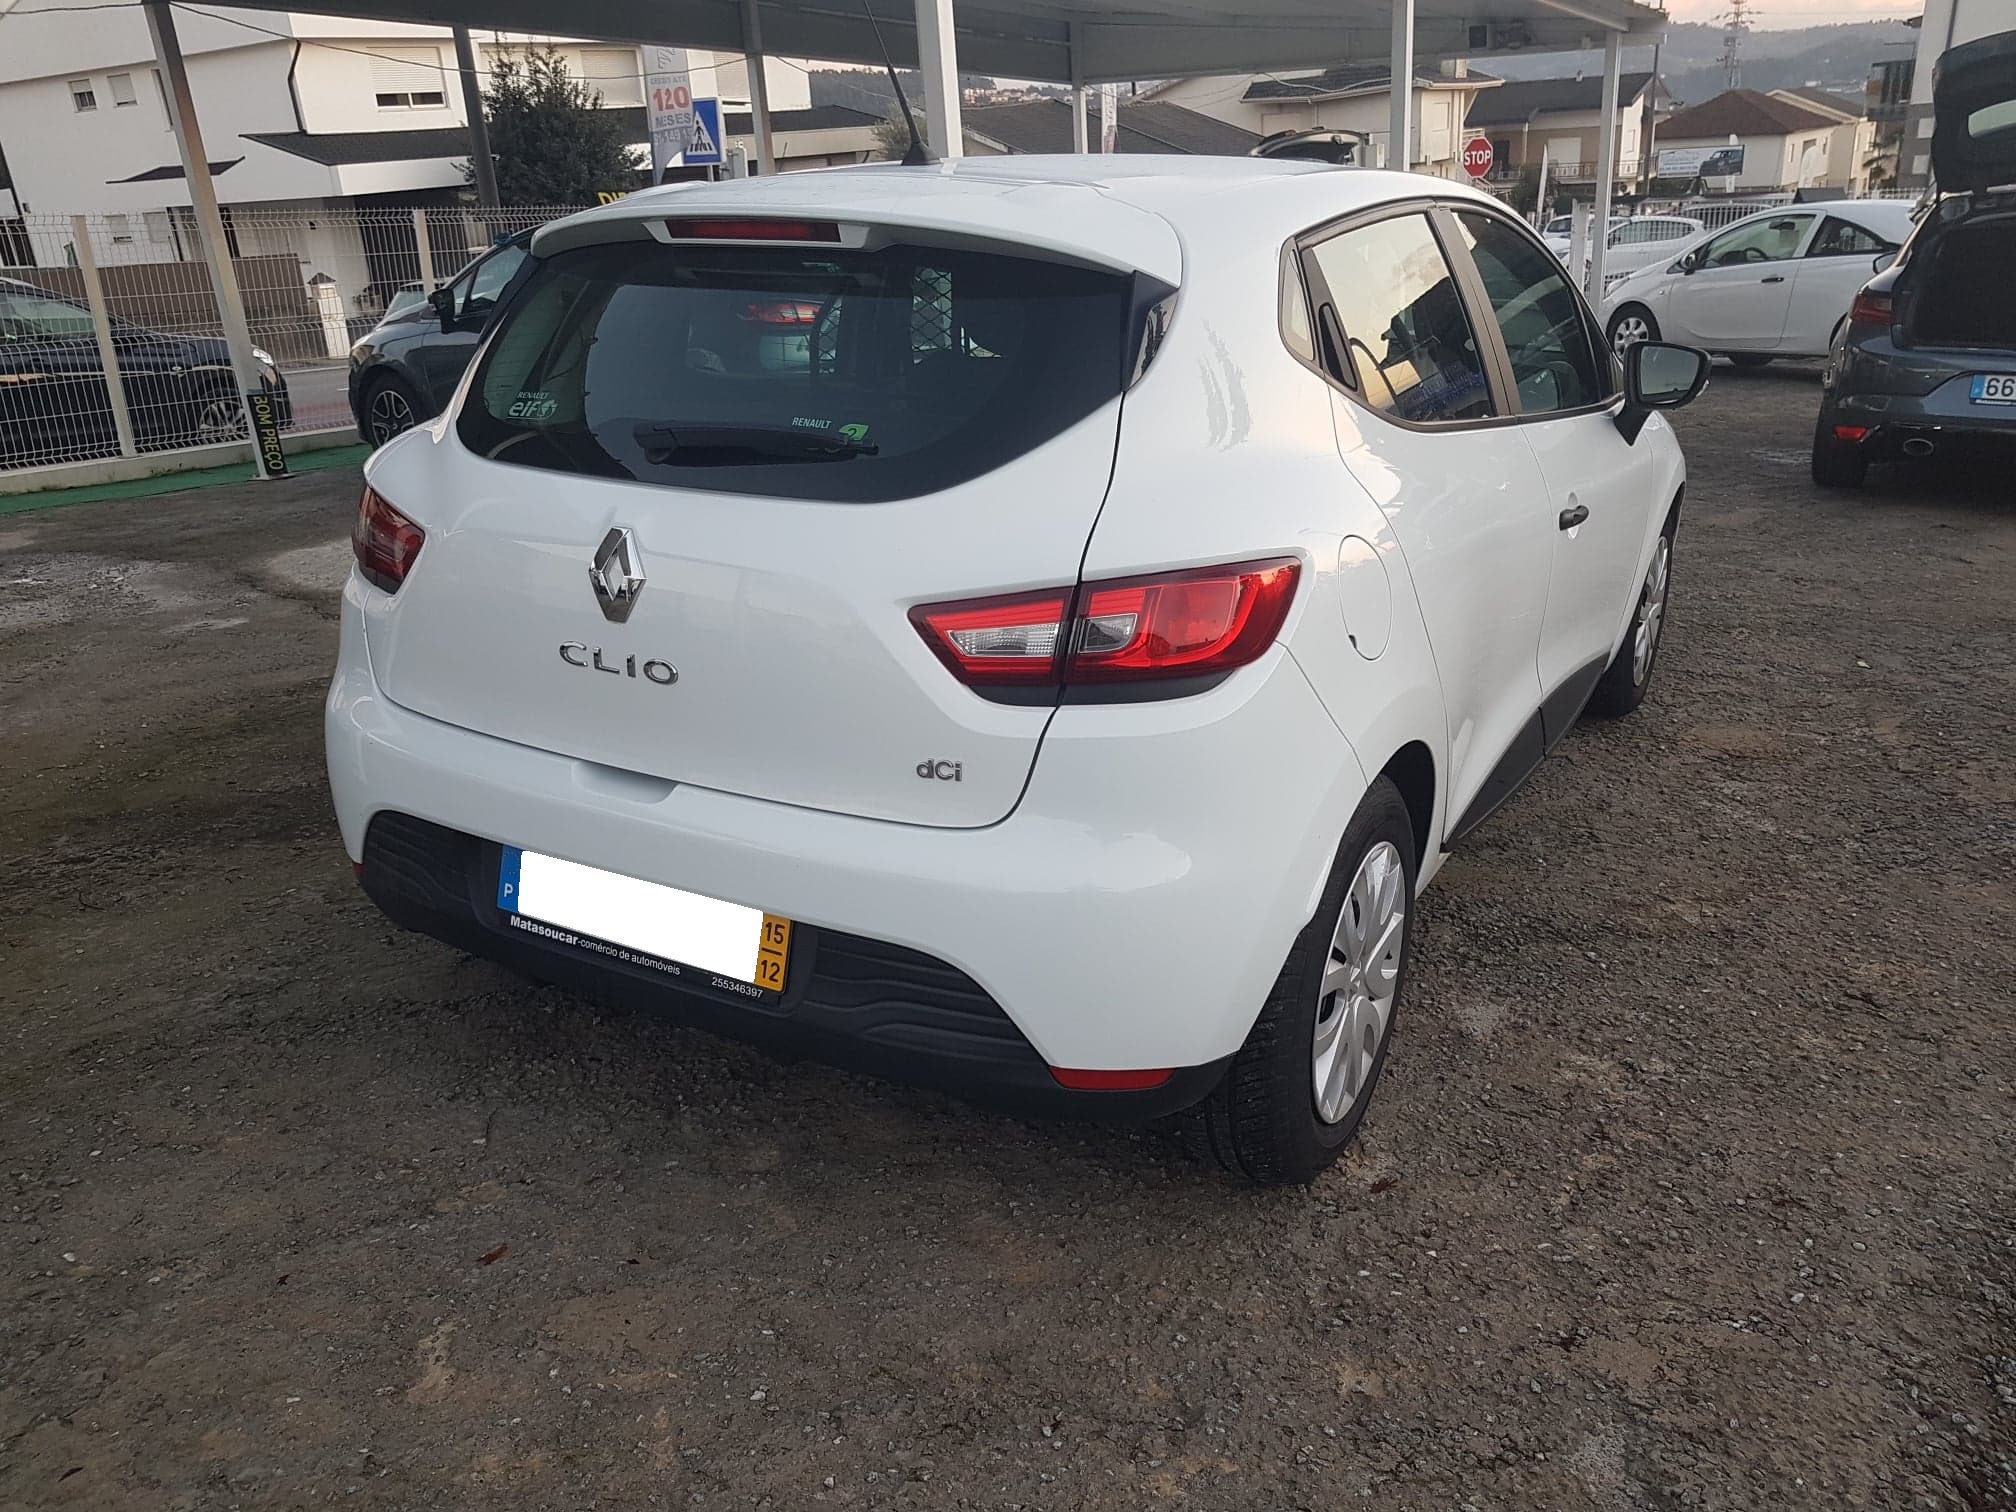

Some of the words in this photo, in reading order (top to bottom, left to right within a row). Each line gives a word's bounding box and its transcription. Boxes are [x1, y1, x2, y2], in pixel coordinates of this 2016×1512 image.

[653, 86, 690, 111] 120
[656, 113, 692, 128] MESES
[1464, 150, 1491, 166] STOP
[253, 396, 273, 425] BOM
[509, 400, 541, 417] elf
[792, 417, 831, 429] RENAULT
[261, 428, 284, 470] PREÇO
[559, 640, 679, 685] CLIO
[916, 759, 963, 782] dCi
[504, 882, 514, 898] P
[765, 921, 785, 945] 15
[619, 949, 630, 961] de
[631, 954, 681, 976] automóveis
[711, 976, 764, 999] 255346397
[760, 958, 782, 983] 12
